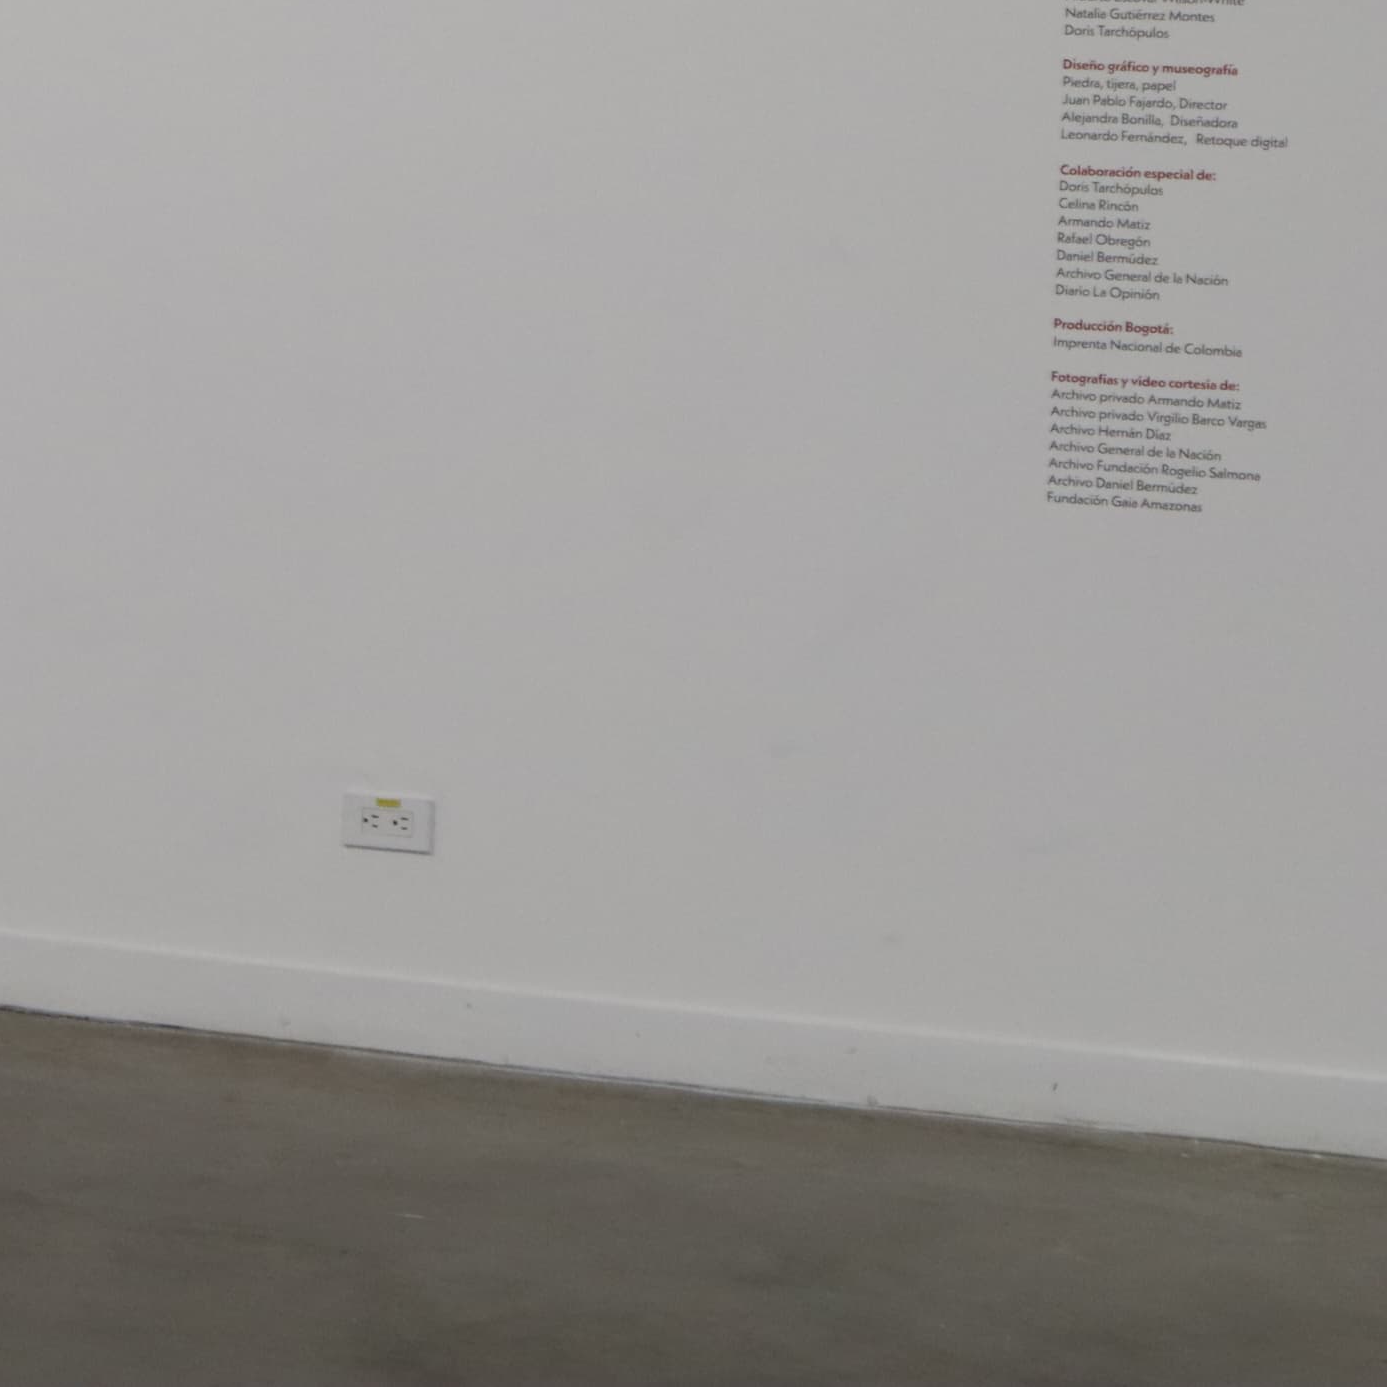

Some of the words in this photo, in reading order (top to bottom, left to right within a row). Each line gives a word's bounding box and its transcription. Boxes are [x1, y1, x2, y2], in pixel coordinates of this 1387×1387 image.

[1062, 58, 1105, 71] Diseño
[1107, 60, 1150, 74] gráfico
[1151, 65, 1160, 76] y
[1162, 63, 1238, 78] museografía
[1059, 164, 1142, 178] Colaboración
[1143, 169, 1194, 182] especial
[1053, 317, 1123, 332] Producción
